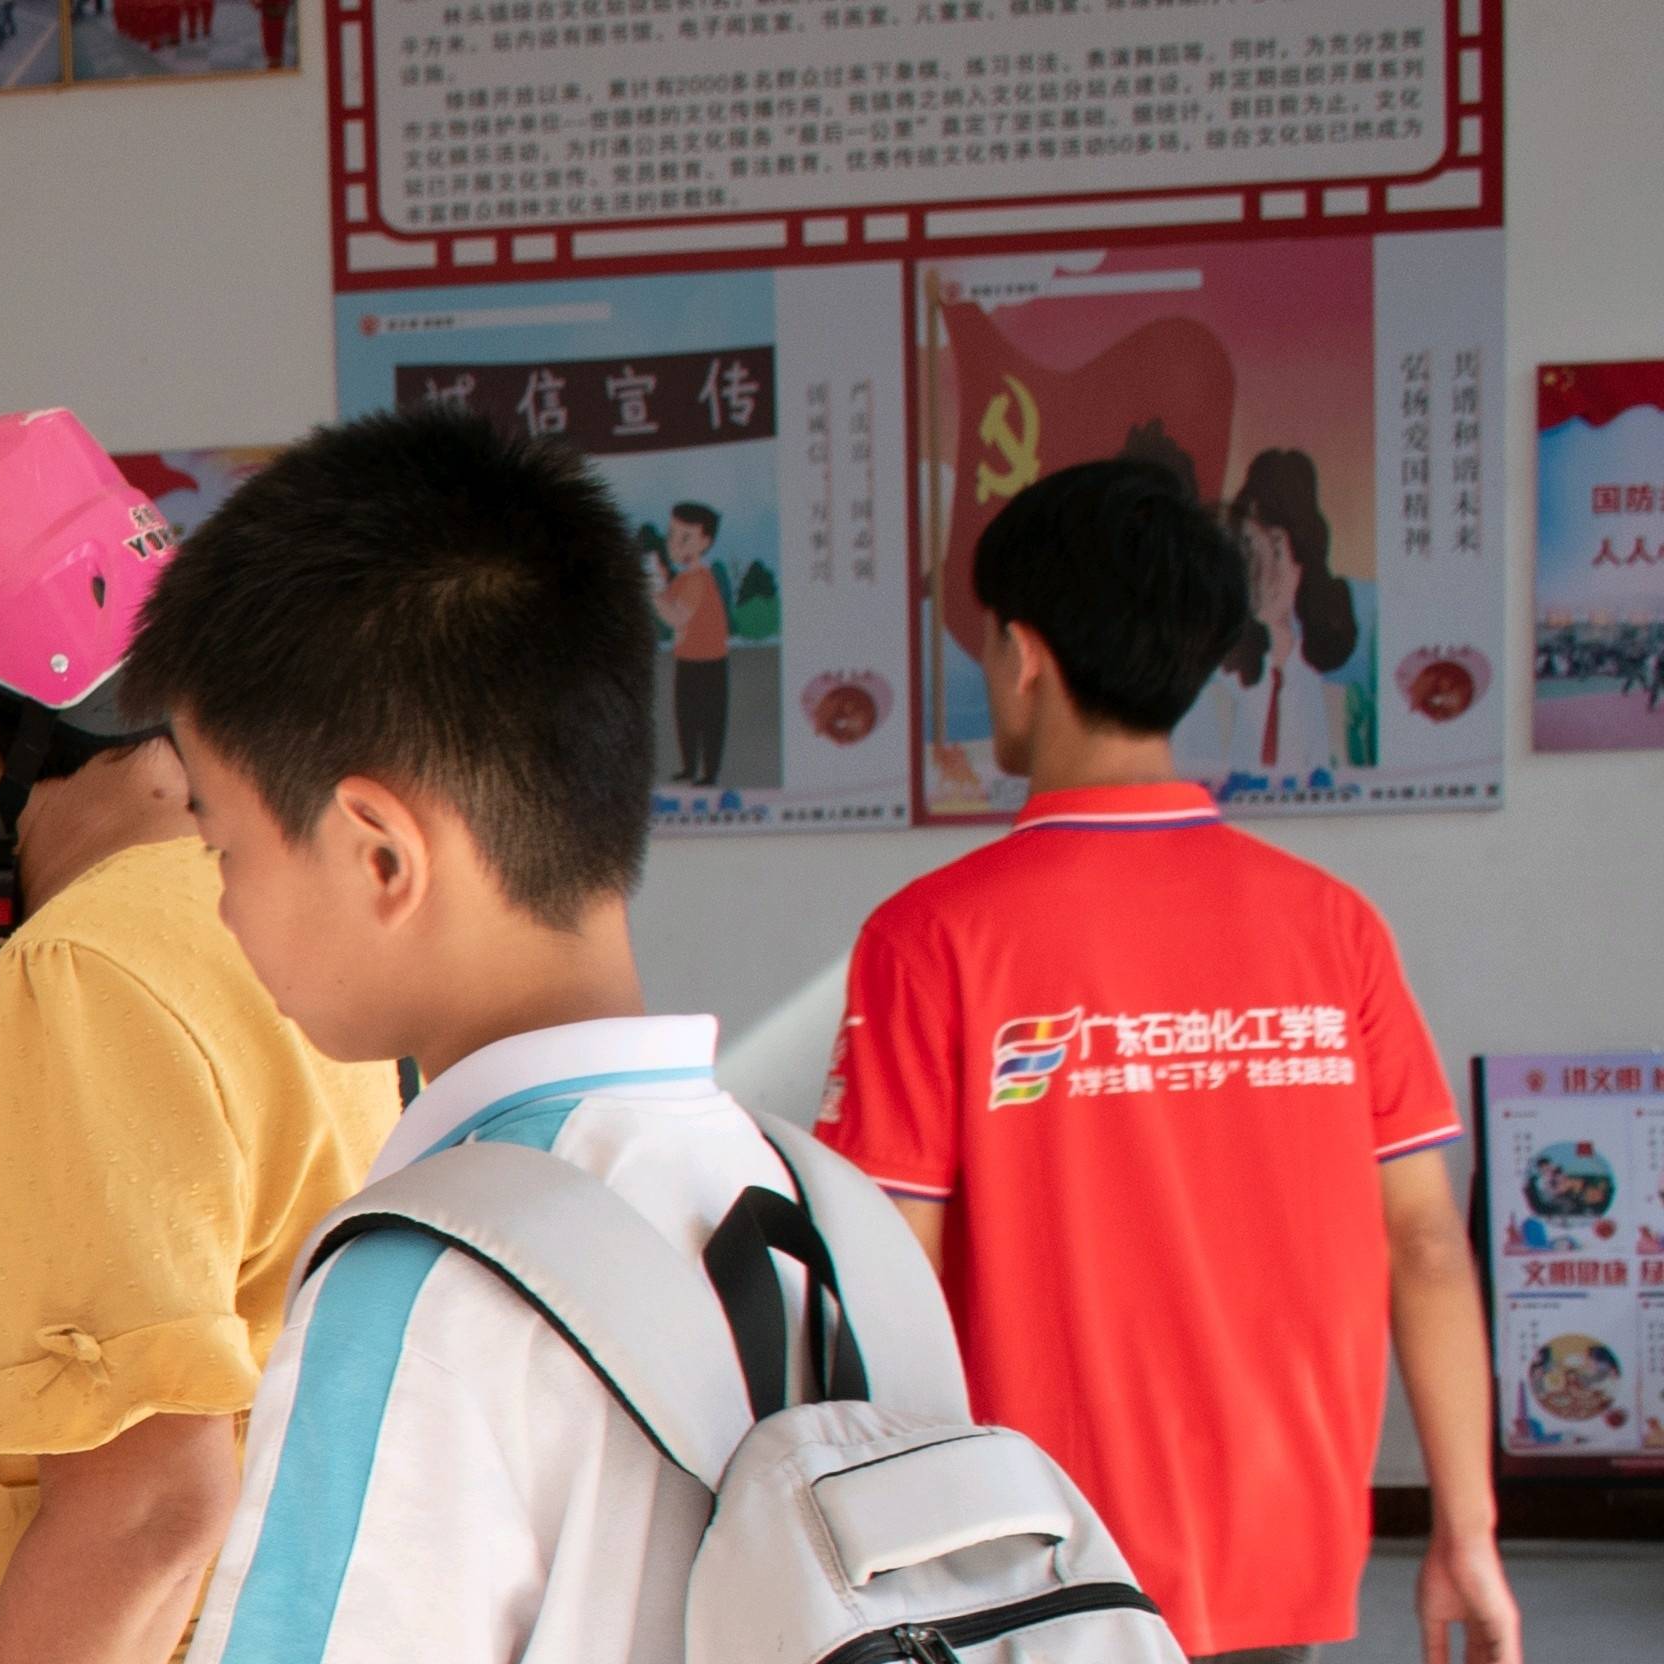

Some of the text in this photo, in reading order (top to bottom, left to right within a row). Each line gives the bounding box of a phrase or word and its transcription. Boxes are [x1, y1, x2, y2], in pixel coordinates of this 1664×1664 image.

[1592, 484, 1664, 514] 国防
[1592, 535, 1664, 567] 人人
[1079, 1005, 1347, 1060] 广东石油化工学院
